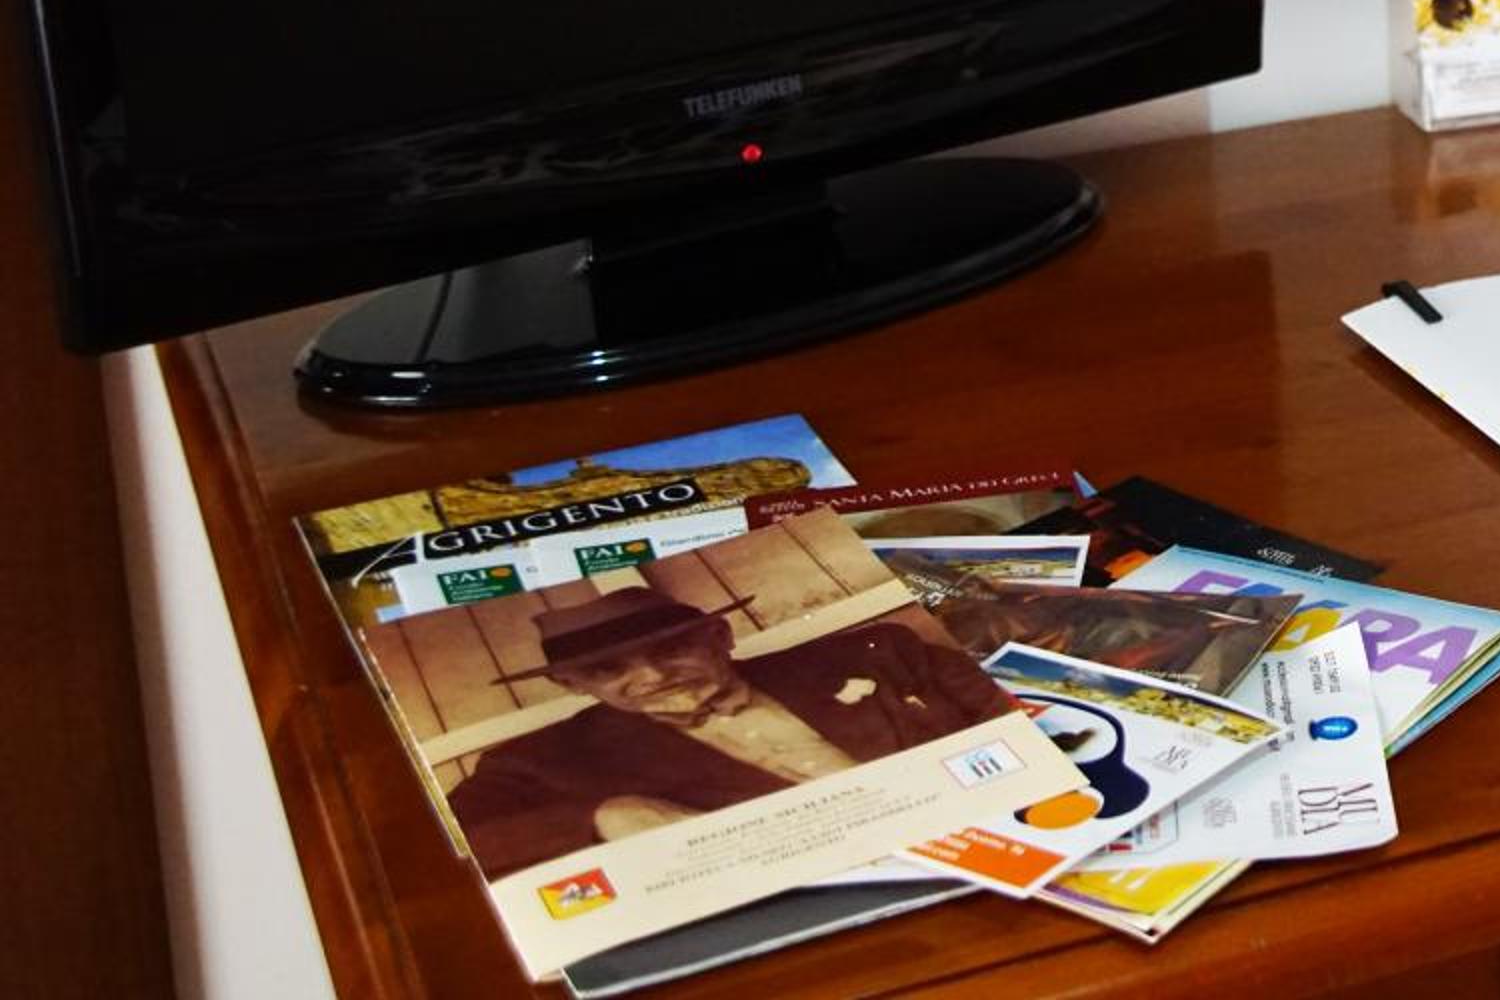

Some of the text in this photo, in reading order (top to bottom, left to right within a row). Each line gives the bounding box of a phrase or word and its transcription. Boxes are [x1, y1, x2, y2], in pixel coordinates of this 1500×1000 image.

[684, 73, 803, 119] TELEFUNKEN
[350, 482, 699, 588] AGRIGENTO
[580, 545, 625, 560] FAI
[443, 568, 489, 585] FAI
